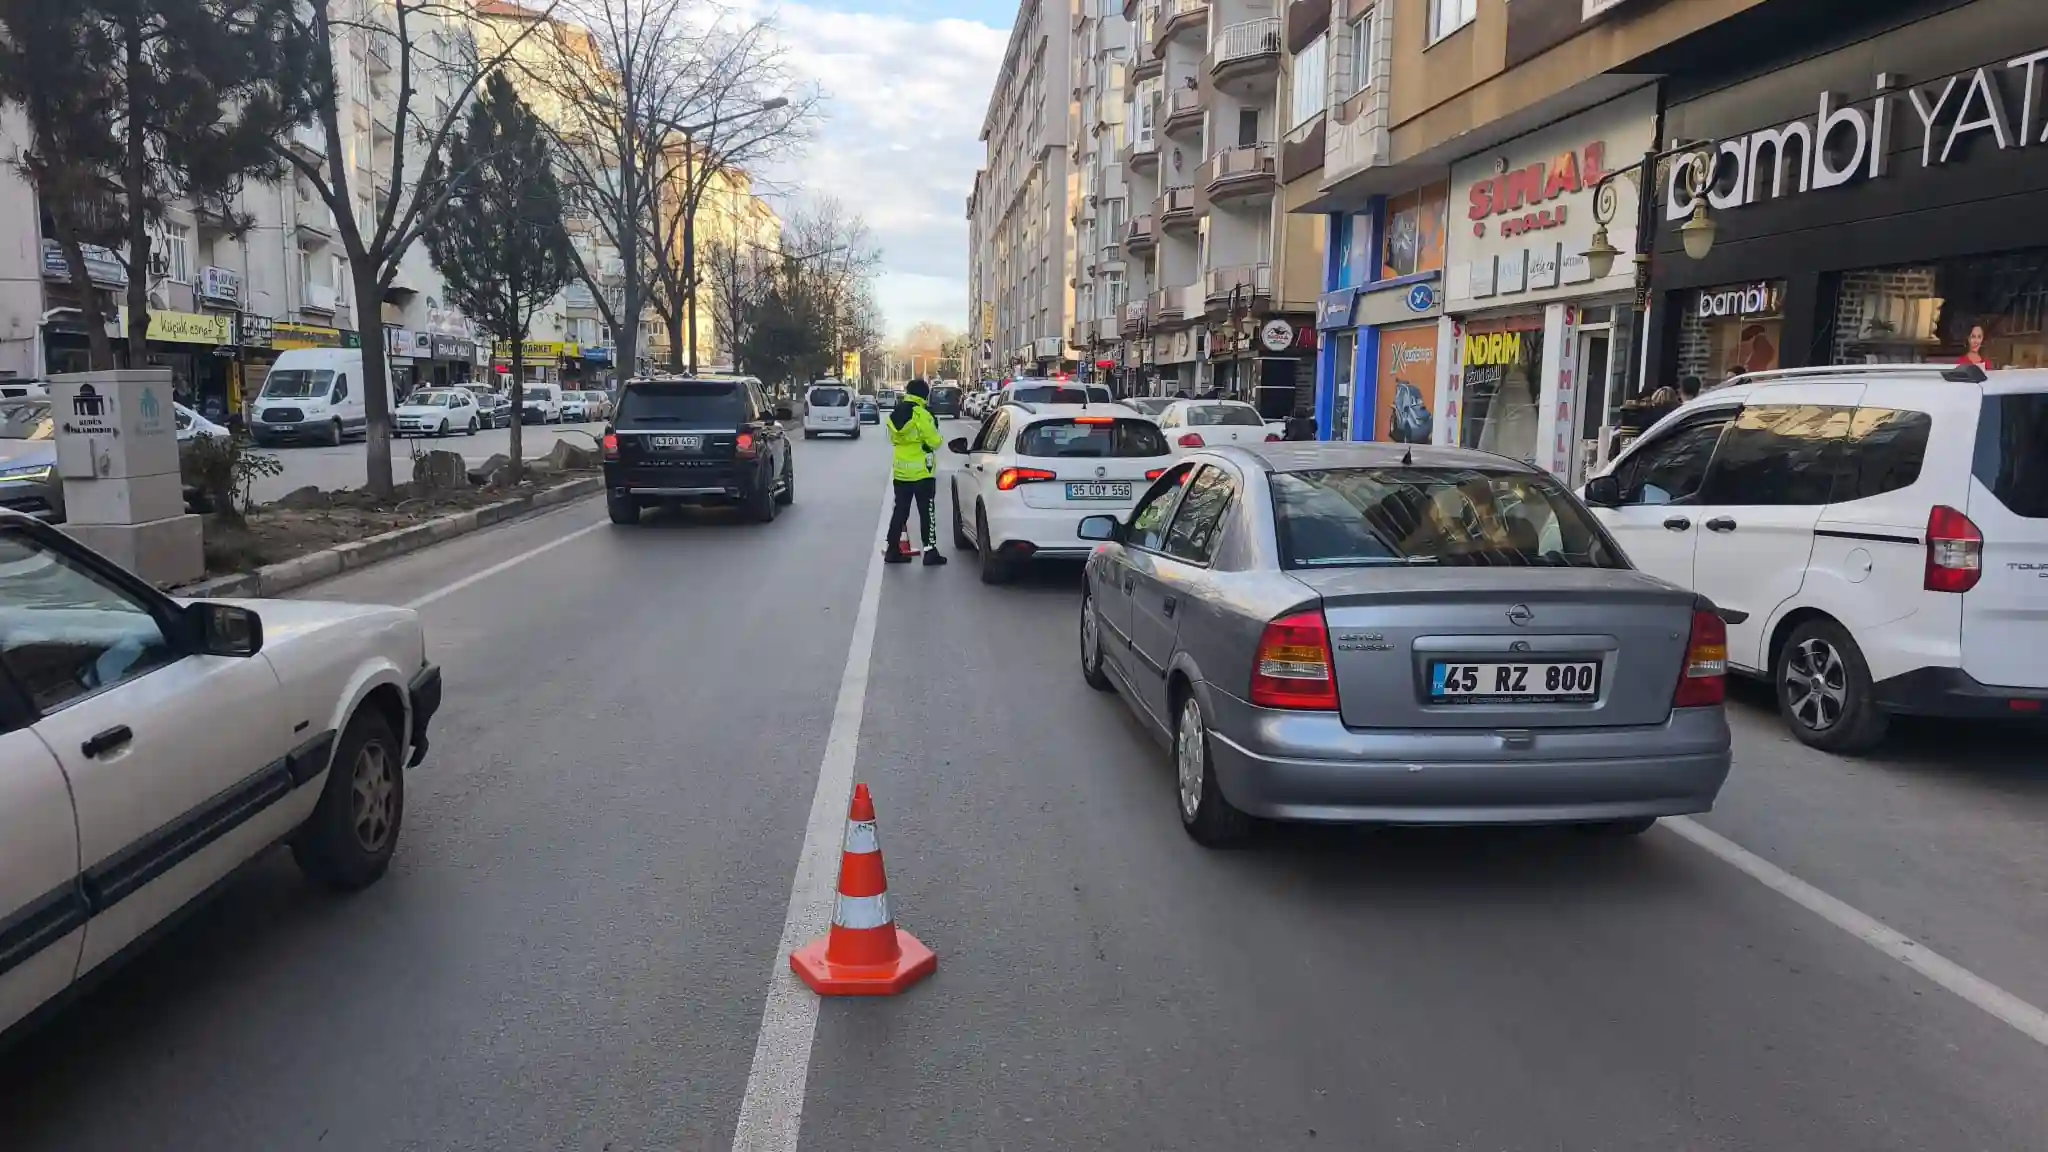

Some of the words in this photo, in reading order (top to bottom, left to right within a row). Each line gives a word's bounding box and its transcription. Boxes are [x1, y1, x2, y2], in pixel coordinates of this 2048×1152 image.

[1666, 73, 1887, 221] bambi
[1909, 50, 2048, 167] YAT
[1700, 281, 1766, 317] bambi
[1072, 484, 1085, 496] 35
[1111, 484, 1130, 496] 556
[1444, 666, 1479, 692] 45
[1495, 666, 1529, 692] RZ
[1545, 665, 1593, 691] 800
